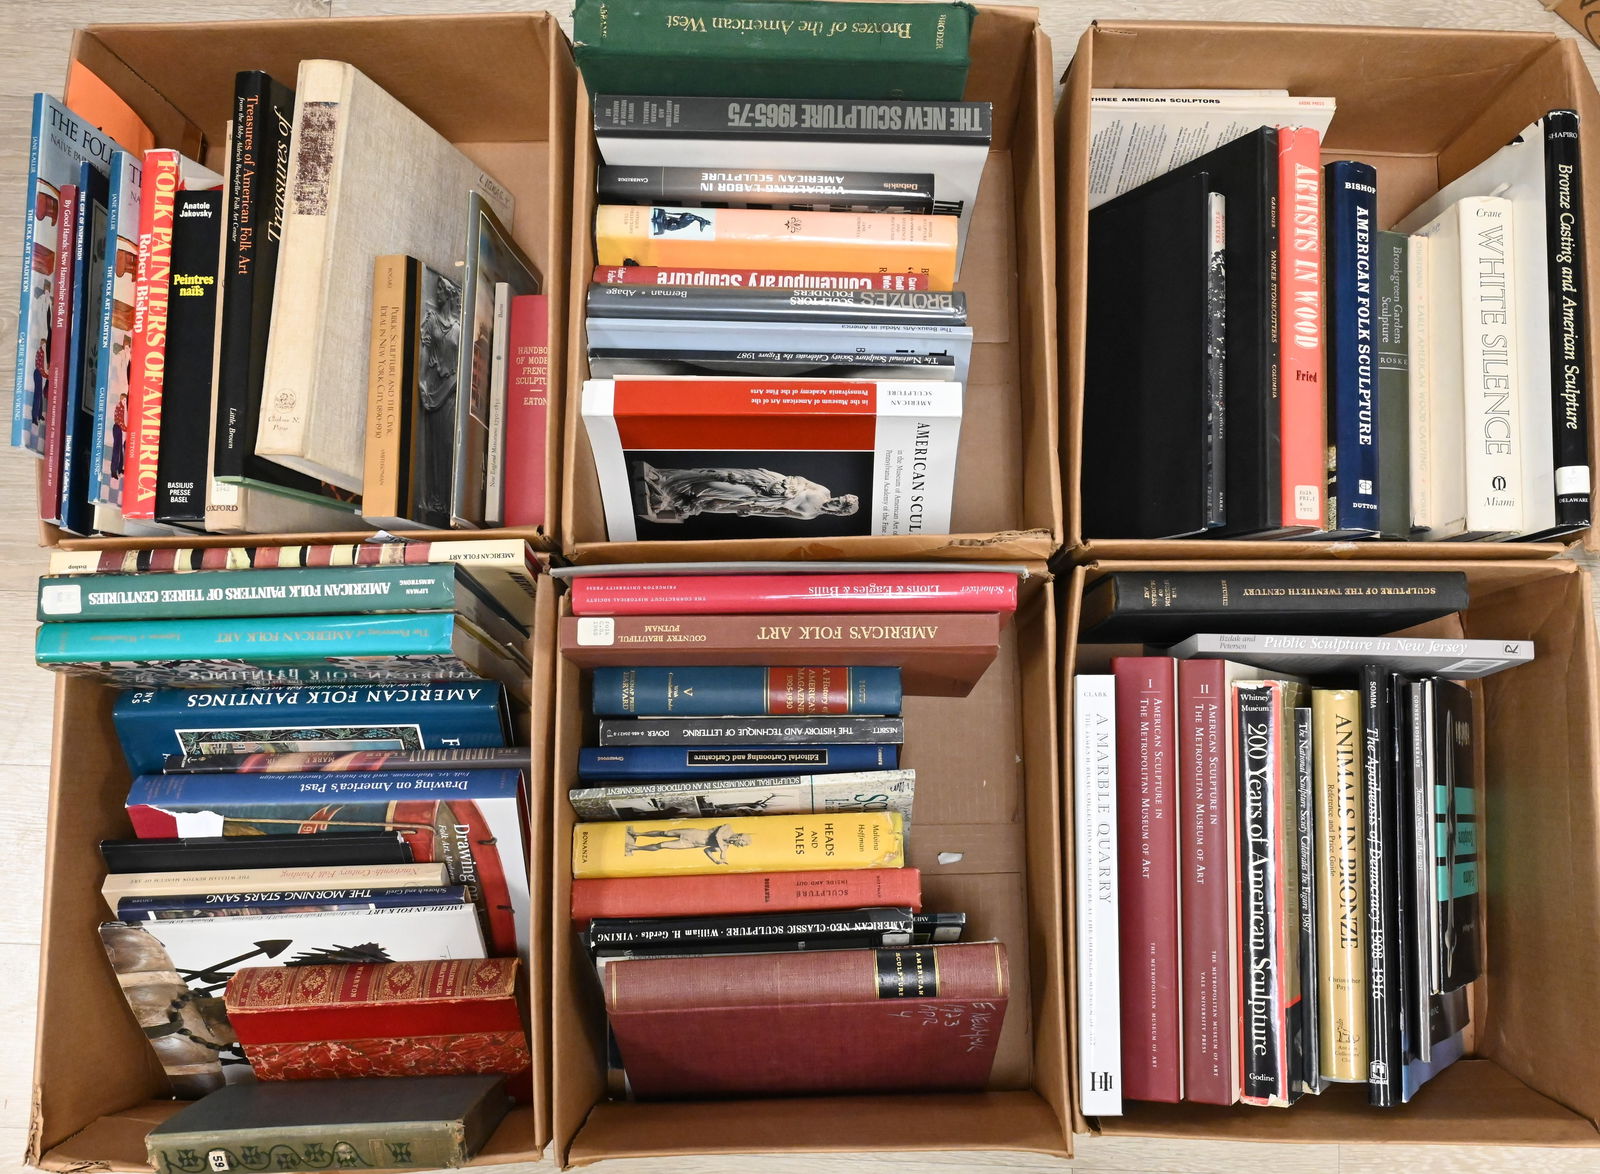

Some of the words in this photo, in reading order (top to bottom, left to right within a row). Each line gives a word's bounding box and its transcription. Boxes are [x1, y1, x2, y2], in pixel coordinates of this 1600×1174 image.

[666, 15, 707, 33] West
[712, 17, 793, 36] American
[798, 21, 823, 37] the
[826, 22, 847, 37] of
[852, 22, 911, 39] Bronzes
[935, 15, 947, 50] BRODER
[244, 95, 259, 150] Treasures
[728, 103, 798, 128] 1965-75
[801, 104, 901, 129] SCULPTURE
[905, 106, 946, 130] NEW
[950, 107, 982, 130] THE
[244, 154, 256, 165] of
[702, 172, 773, 183] SCULPTURE
[778, 173, 844, 184] AMERICAN
[154, 160, 176, 218] FOLK
[1344, 181, 1376, 194] BISHOP
[1559, 164, 1573, 209] Bronze
[240, 168, 255, 223] American
[63, 200, 71, 208] By
[183, 202, 211, 212] Anatole
[1294, 163, 1319, 252] ARTISTS
[180, 209, 213, 219] Jakovsky
[1476, 208, 1502, 218] Crane
[62, 228, 70, 250] Hands:
[240, 227, 252, 251] Folk
[1556, 212, 1575, 263] Casting
[137, 234, 151, 281] Robert
[1356, 206, 1369, 293] AMERICAN
[238, 255, 251, 274] Art
[1294, 259, 1318, 286] IN
[173, 274, 214, 289] Peintres
[1390, 247, 1403, 302] Brookgreen
[1477, 225, 1507, 325] WHITE
[1561, 267, 1576, 292] and
[58, 267, 67, 301] Hampshire
[146, 226, 172, 347] PAINTERS
[793, 289, 854, 298] FOUNDERS
[859, 291, 952, 309] BRONZES
[133, 286, 149, 333] Bishop
[1293, 290, 1318, 349] WOOD
[1357, 296, 1370, 340] FOLK
[1378, 297, 1392, 343] Sculpture
[1393, 305, 1402, 344] Gardens
[1562, 295, 1578, 360] American
[737, 352, 755, 360] 1987
[758, 351, 781, 360] Figure
[796, 353, 829, 361] Celebrates
[831, 352, 853, 363] Society
[856, 353, 886, 363] Sculpture
[889, 354, 921, 365] National
[924, 356, 938, 365] The
[145, 352, 164, 386] OF
[1296, 370, 1317, 383] Fried
[1358, 344, 1372, 446] SCULPTURE
[1481, 333, 1512, 455] SILENCE
[1560, 365, 1580, 429] Sculpture
[227, 408, 236, 425] Little,
[137, 387, 162, 502] AMERICA
[228, 427, 236, 448] Brown
[206, 504, 238, 512] OXFORD
[324, 582, 391, 597] AMERICAN
[400, 578, 435, 586] ARMSTRONG
[88, 590, 158, 605] CENTURIES
[160, 589, 204, 603] THREE
[206, 589, 223, 601] OF
[225, 586, 286, 600] PAINTERS
[290, 584, 321, 598] FOLK
[1243, 588, 1286, 596] CENTURY
[1287, 587, 1342, 596] TWENTIETH
[1344, 587, 1364, 596] THE
[1366, 587, 1378, 596] OF
[1380, 587, 1436, 596] SCULPTURE
[618, 635, 663, 643] BEAUTIFUL
[666, 634, 706, 642] COUNTRY
[756, 626, 792, 640] ART
[799, 626, 842, 639] FOLK
[849, 626, 938, 639] AMERICA'S
[1263, 636, 1306, 649] Public
[1309, 638, 1373, 652] Sculpture
[1377, 640, 1390, 650] in
[1392, 640, 1425, 652] New
[1426, 641, 1468, 655] Jersey
[187, 691, 299, 708] PAINTINGS
[305, 690, 358, 704] FOLK
[366, 688, 481, 702] AMERICAN
[1240, 693, 1270, 701] Whitney
[1096, 713, 1108, 726] A
[683, 729, 723, 737] LETTERING
[738, 726, 782, 736] TECHNIQUE
[1247, 723, 1268, 759] 200
[747, 753, 786, 761] Cartooning
[1096, 732, 1110, 814] MARBLE
[1335, 714, 1356, 819] ANIMALS
[300, 783, 327, 792] Past
[331, 782, 393, 792] America's
[415, 780, 468, 790] Drawing
[1248, 766, 1269, 819] Years
[795, 825, 804, 856] TALES
[824, 822, 834, 857] HEADS
[1250, 824, 1269, 847] of
[1338, 826, 1356, 852] IN
[1328, 835, 1336, 853] Price
[1097, 823, 1112, 904] QUARRY
[206, 893, 241, 903] SANG
[244, 892, 281, 901] STARS
[283, 889, 346, 901] MORNING
[348, 889, 372, 898] THE
[795, 889, 848, 897] SCULPTURE
[1250, 851, 1270, 950] American
[1338, 858, 1358, 949] BRONZE
[1248, 957, 1271, 1056] Sculpture
[1249, 1073, 1274, 1082] Godine
[213, 1156, 225, 1167] 59
